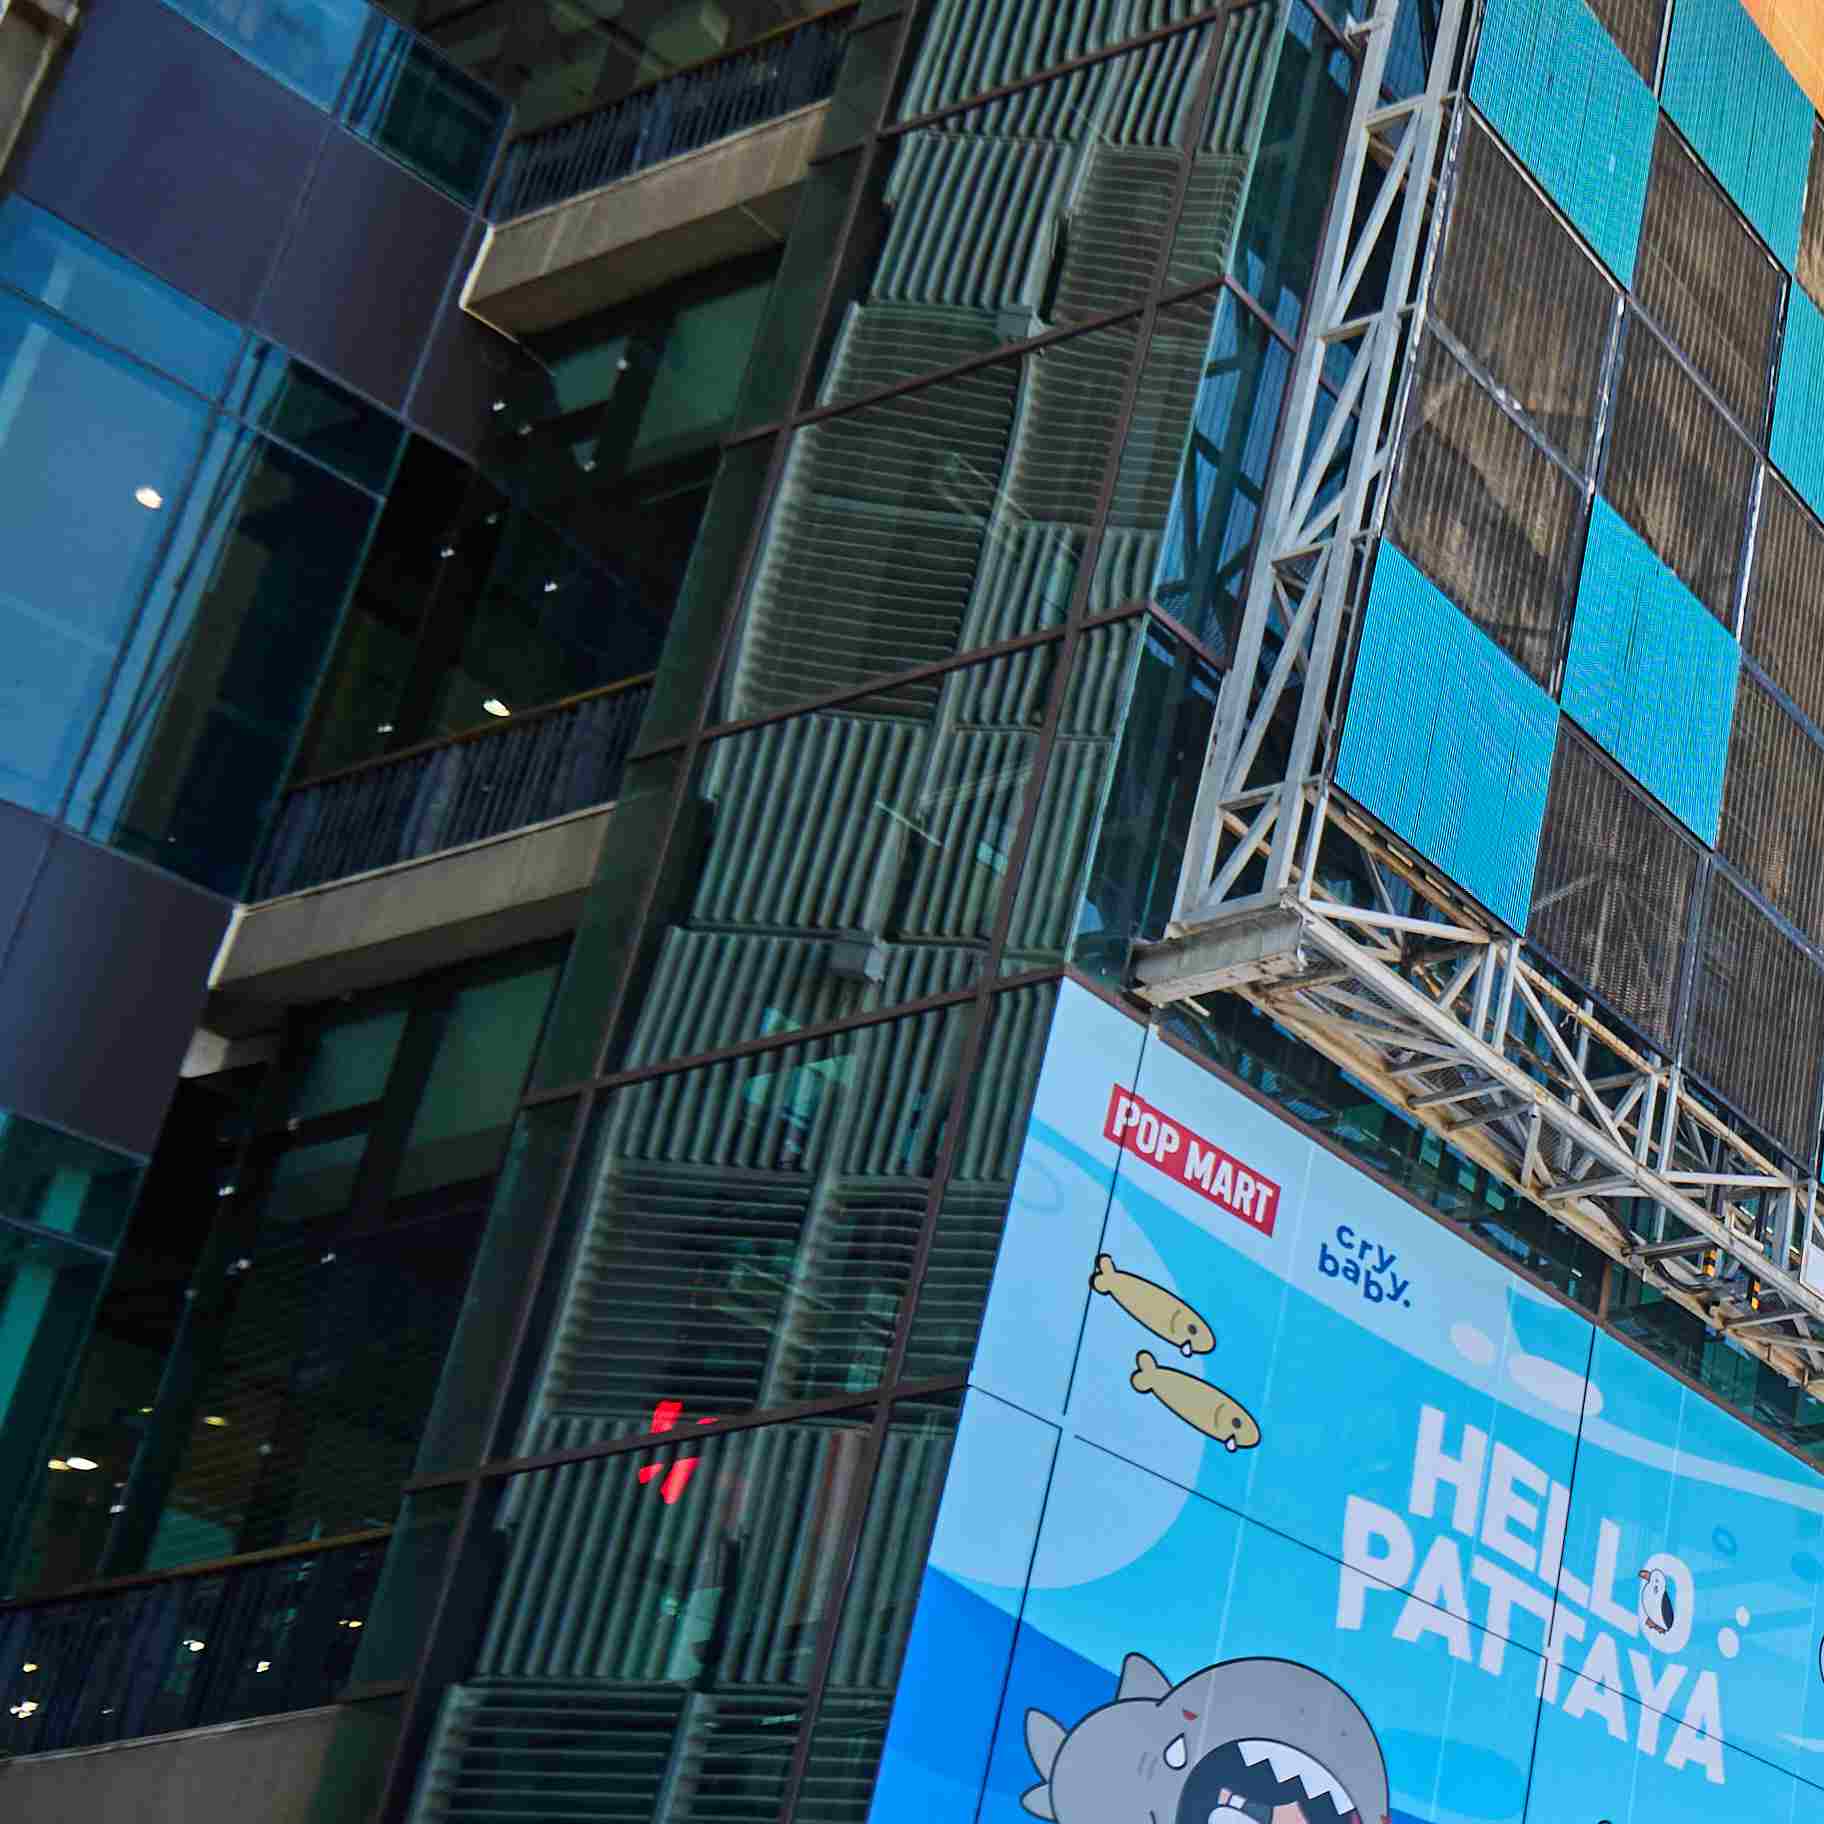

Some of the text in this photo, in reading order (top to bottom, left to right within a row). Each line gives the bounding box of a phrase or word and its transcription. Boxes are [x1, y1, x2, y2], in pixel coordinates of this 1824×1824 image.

[1113, 1098, 1273, 1224] POP MART
[1336, 1494, 1726, 1785] PATTAYA
[1408, 1404, 1695, 1655] HELLO
